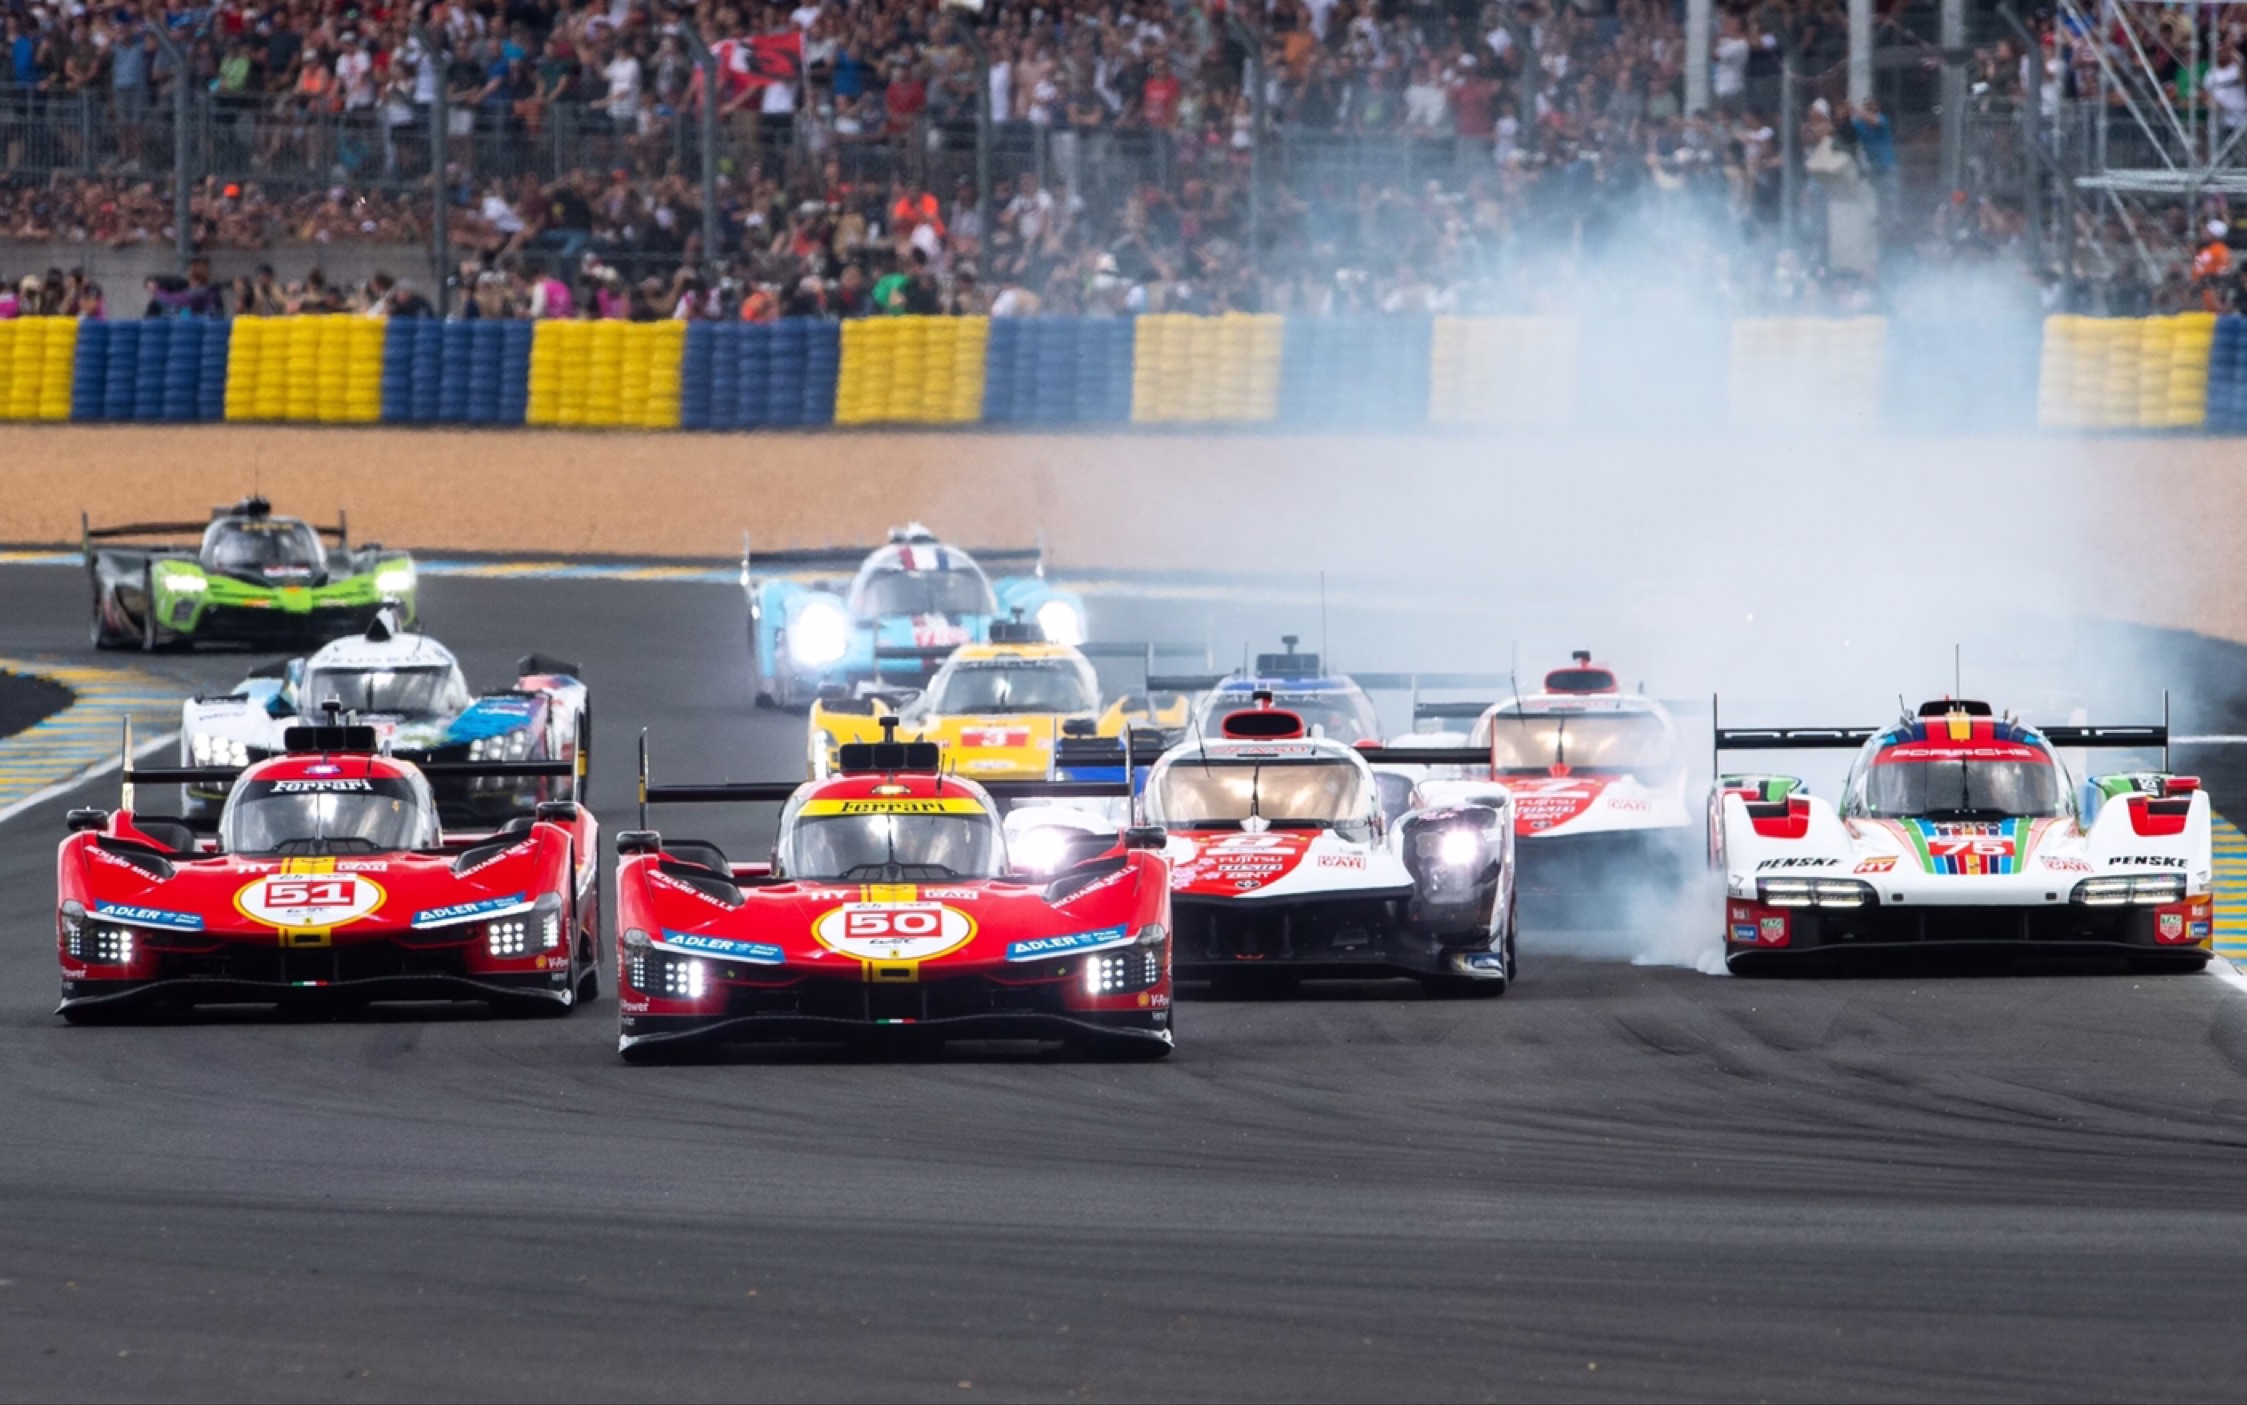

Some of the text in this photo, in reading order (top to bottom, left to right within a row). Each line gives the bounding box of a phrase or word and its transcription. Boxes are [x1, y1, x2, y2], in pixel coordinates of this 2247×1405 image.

[980, 731, 1007, 747] 3
[1891, 748, 2033, 758] PORSCHE
[270, 778, 374, 793] Ferrari
[841, 800, 947, 813] Ferrari
[1936, 841, 2008, 855] 75
[453, 853, 507, 881] RICHARD
[2108, 856, 2189, 869] PENSKE
[268, 883, 351, 905] 51
[696, 892, 737, 913] MILLE
[101, 904, 162, 921] ADLER
[419, 902, 480, 922] ADLER
[849, 911, 939, 935] 50
[666, 934, 734, 952] ADLER
[1014, 934, 1078, 955] ADLER
